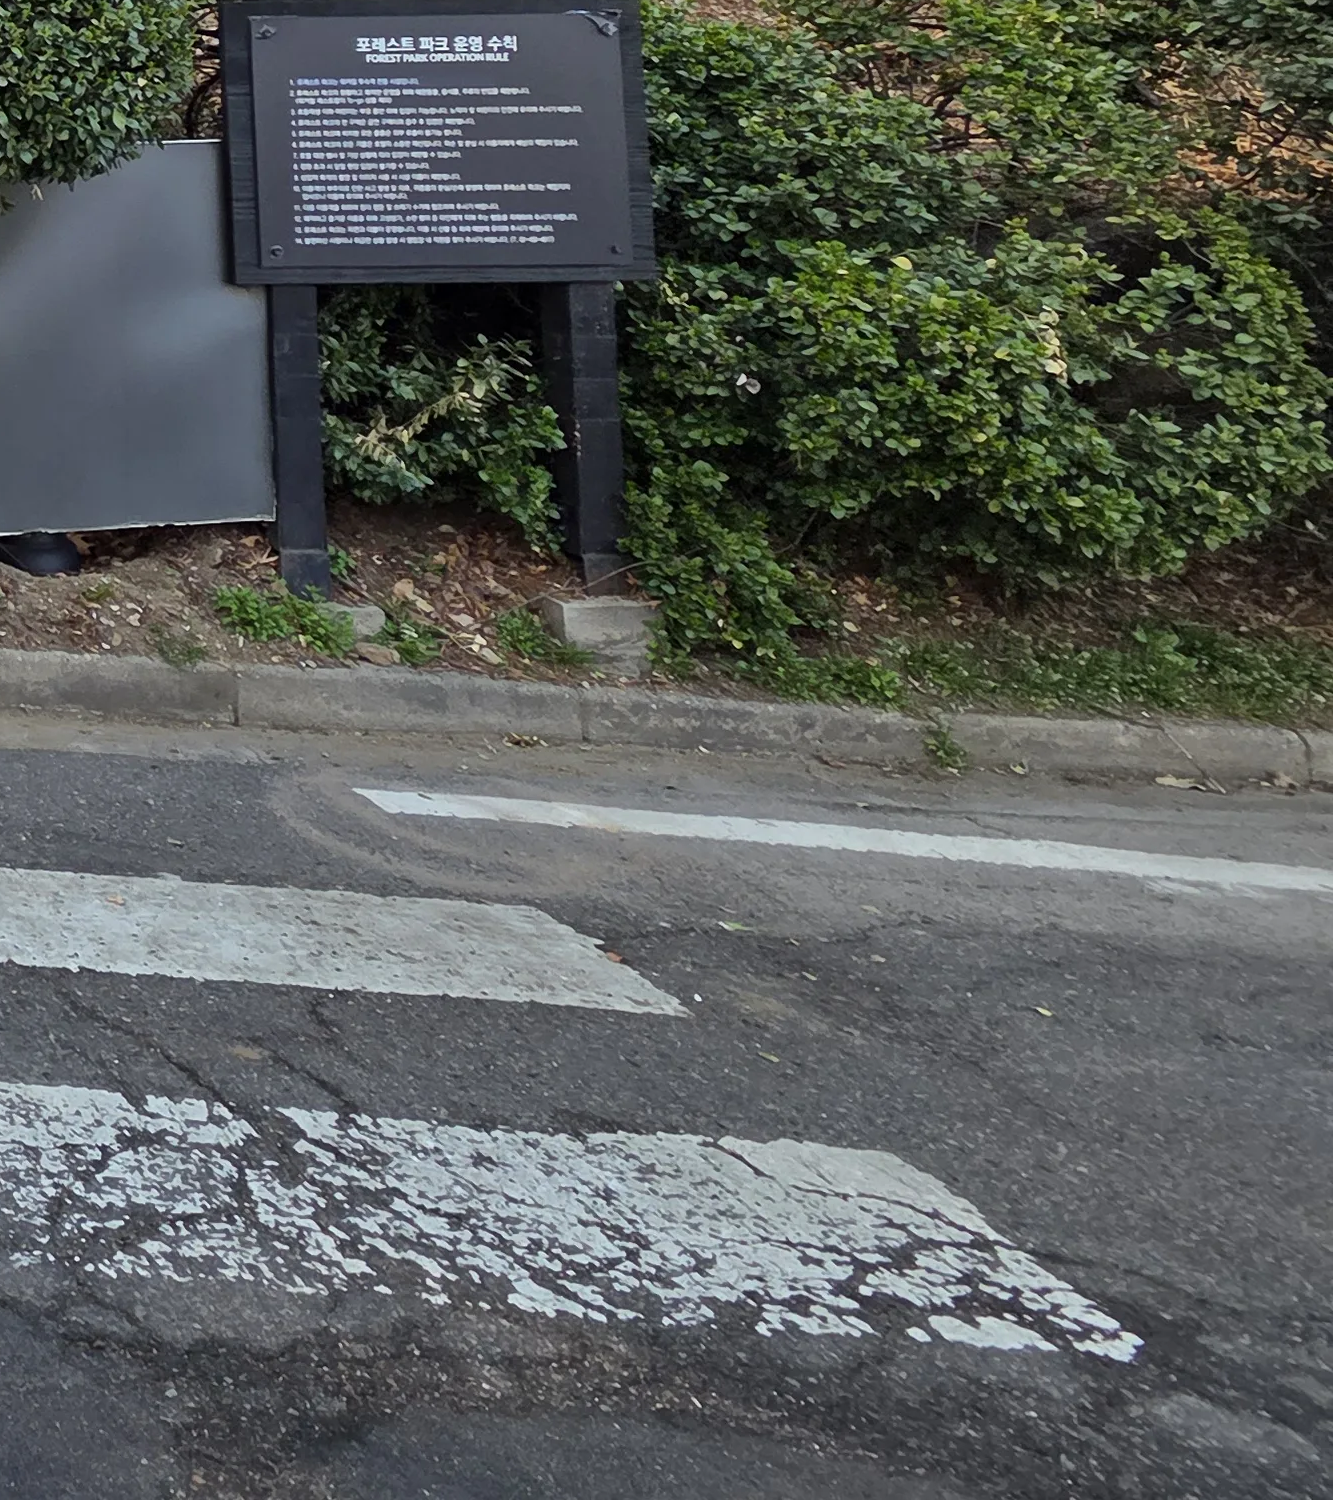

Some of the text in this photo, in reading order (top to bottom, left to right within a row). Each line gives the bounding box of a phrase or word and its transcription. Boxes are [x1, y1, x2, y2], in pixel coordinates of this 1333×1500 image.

[355, 35, 518, 53] 포레스트 파크 운영 수칙
[365, 52, 510, 63] FOREST PARK OPERATION RULE
